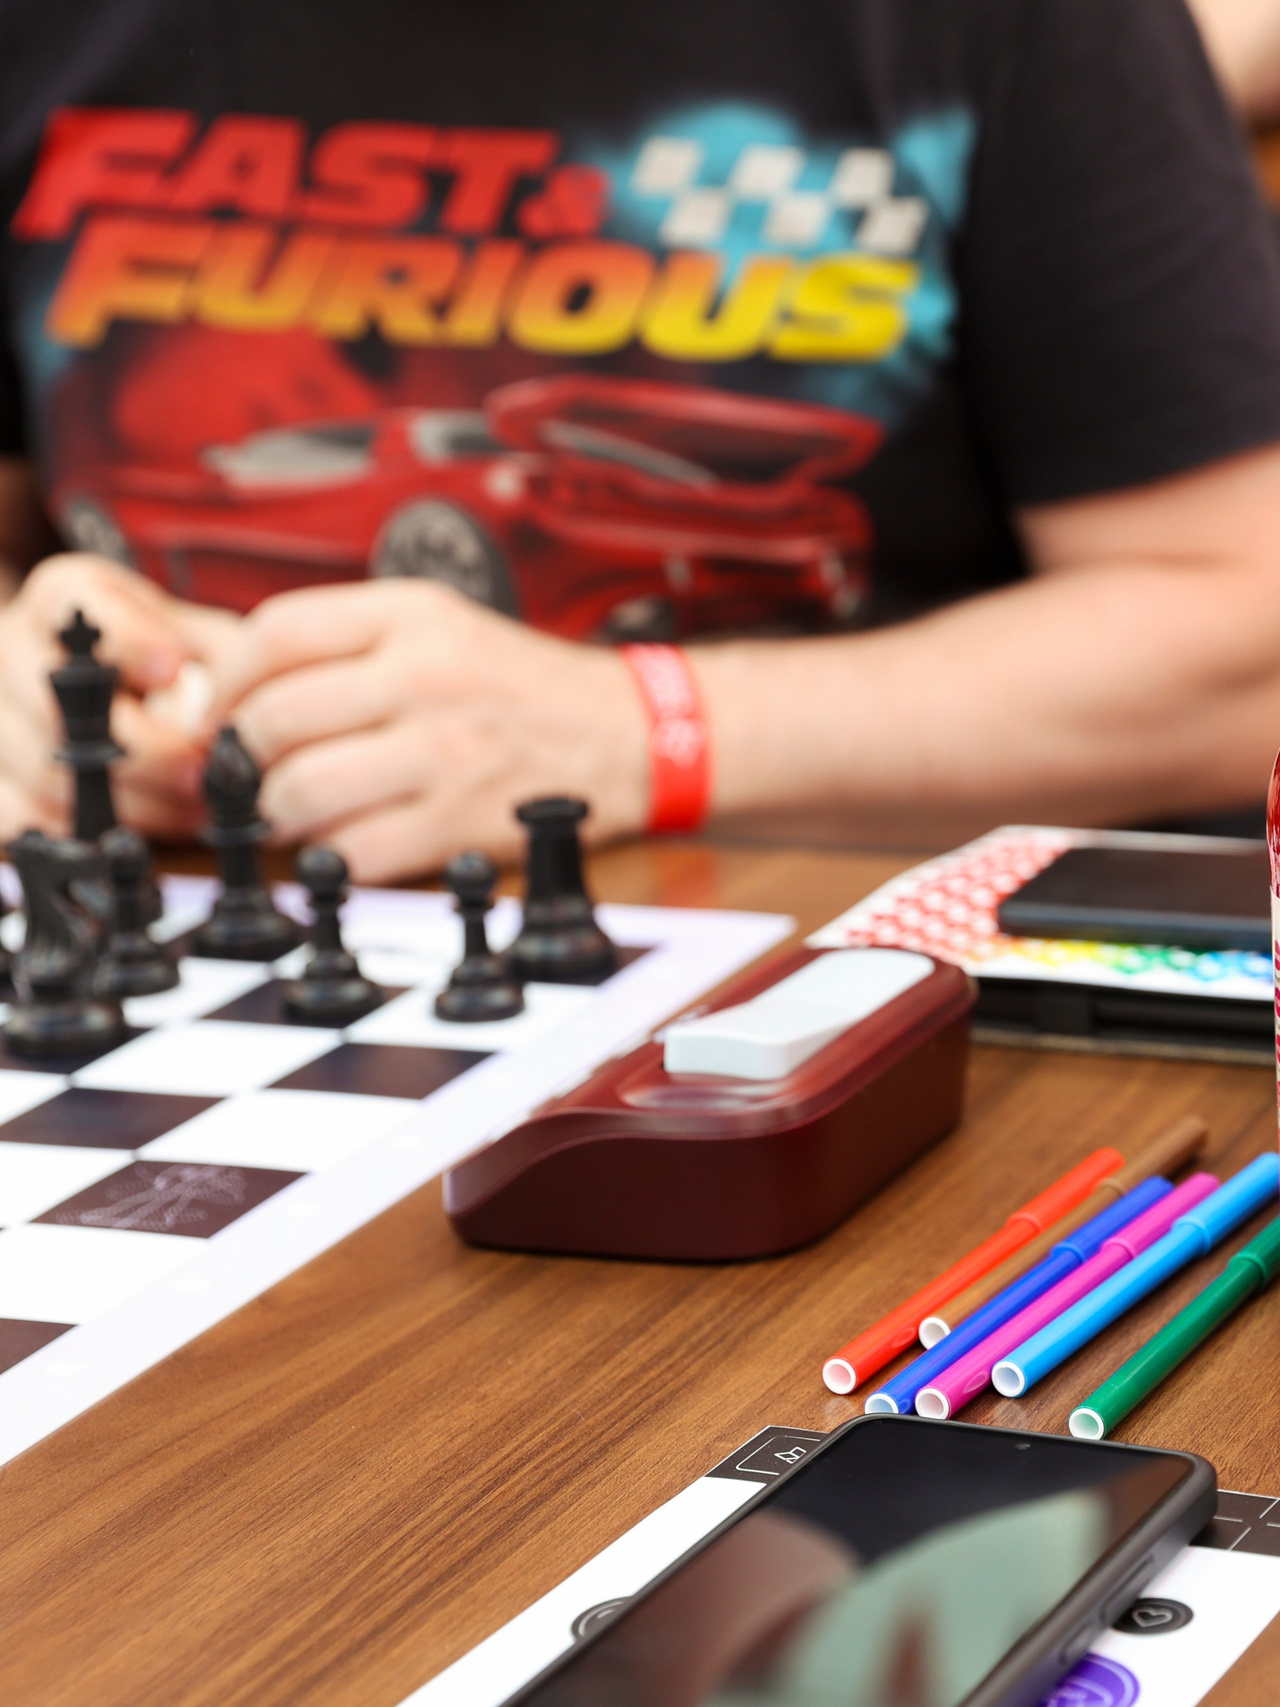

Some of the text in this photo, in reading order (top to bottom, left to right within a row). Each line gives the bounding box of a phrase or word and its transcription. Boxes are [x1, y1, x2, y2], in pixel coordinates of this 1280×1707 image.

[12, 107, 611, 242] FAST &
[47, 214, 918, 363] FURIOUS
